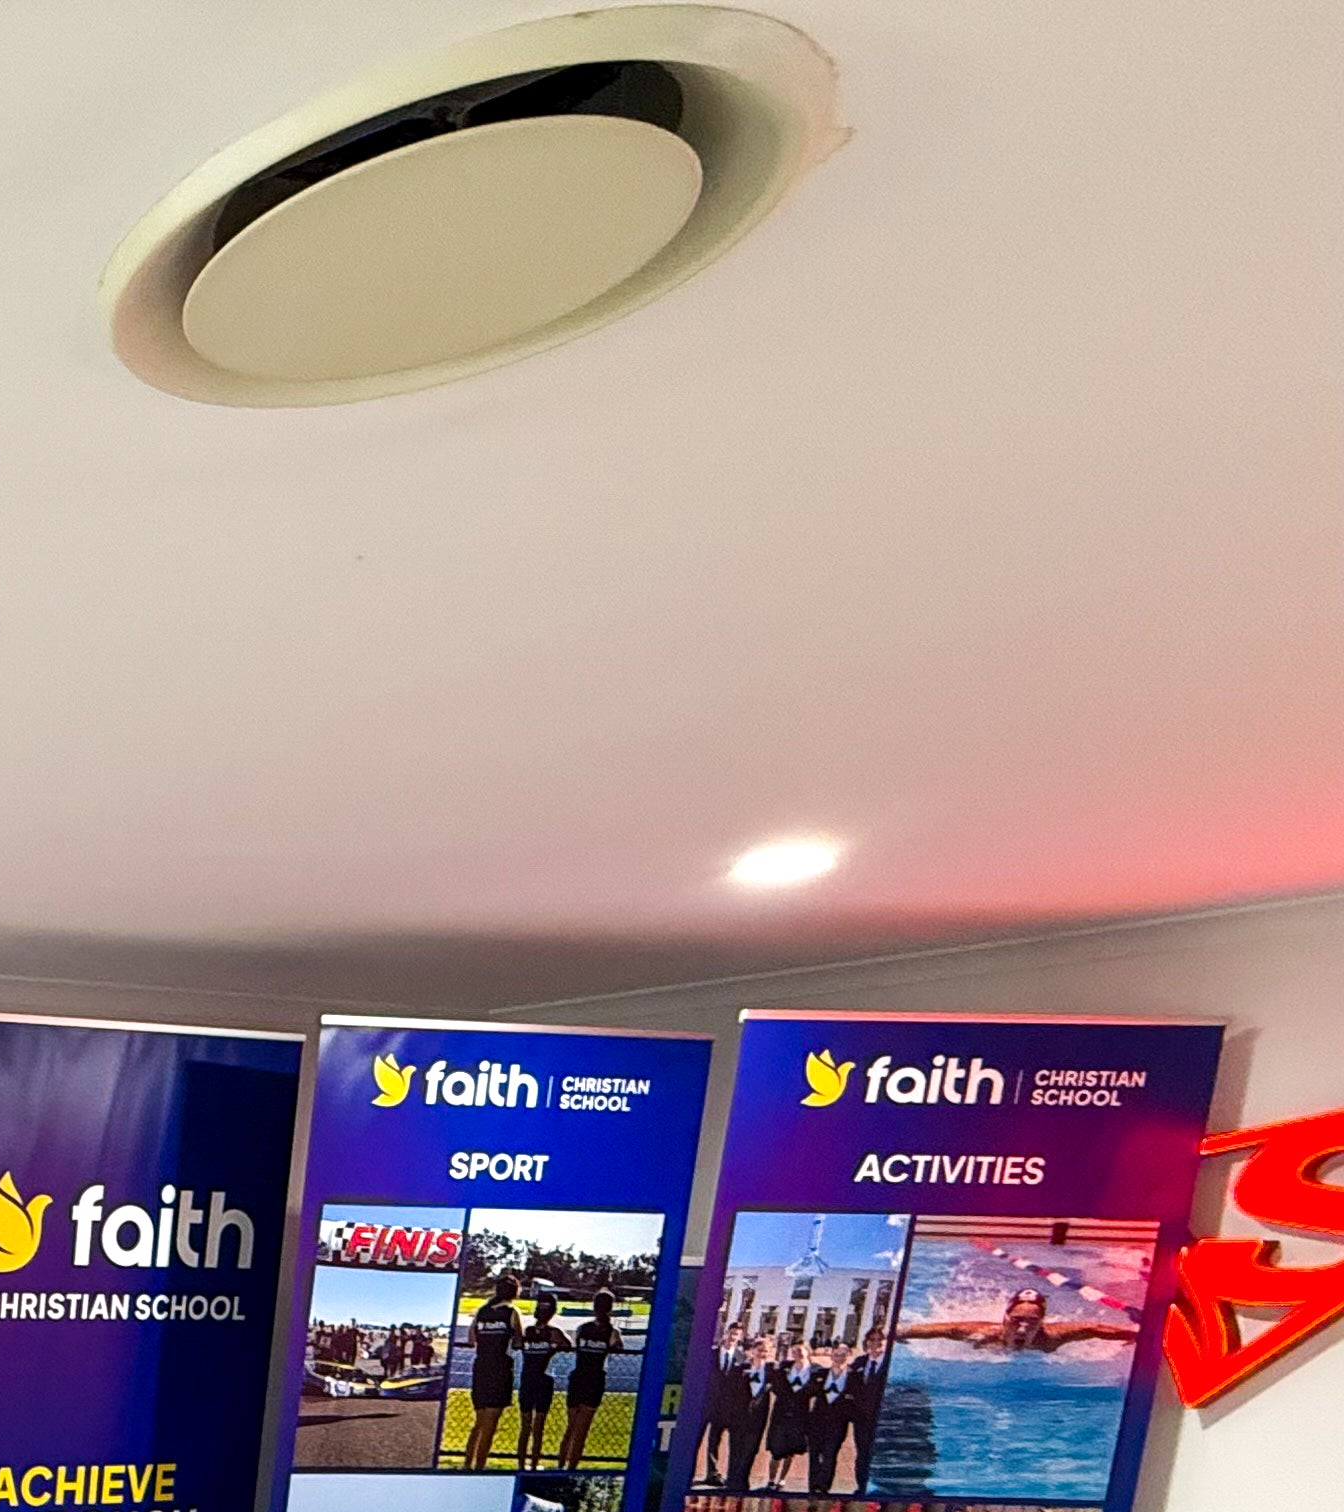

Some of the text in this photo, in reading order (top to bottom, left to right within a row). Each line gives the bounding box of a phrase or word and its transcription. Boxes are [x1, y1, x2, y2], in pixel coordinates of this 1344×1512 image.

[425, 1060, 538, 1109] faith
[561, 1076, 651, 1096] CHRISTIAN
[864, 1054, 1005, 1105] faith
[1033, 1069, 1147, 1089] CHRISTIAN
[559, 1094, 632, 1112] SCHOOL
[1030, 1088, 1123, 1107] SCHOOL
[448, 1151, 550, 1182] SPORT
[853, 1153, 1046, 1185] ACTIVITIES
[71, 1184, 254, 1268] faith
[134, 1294, 245, 1321] SCHOOL
